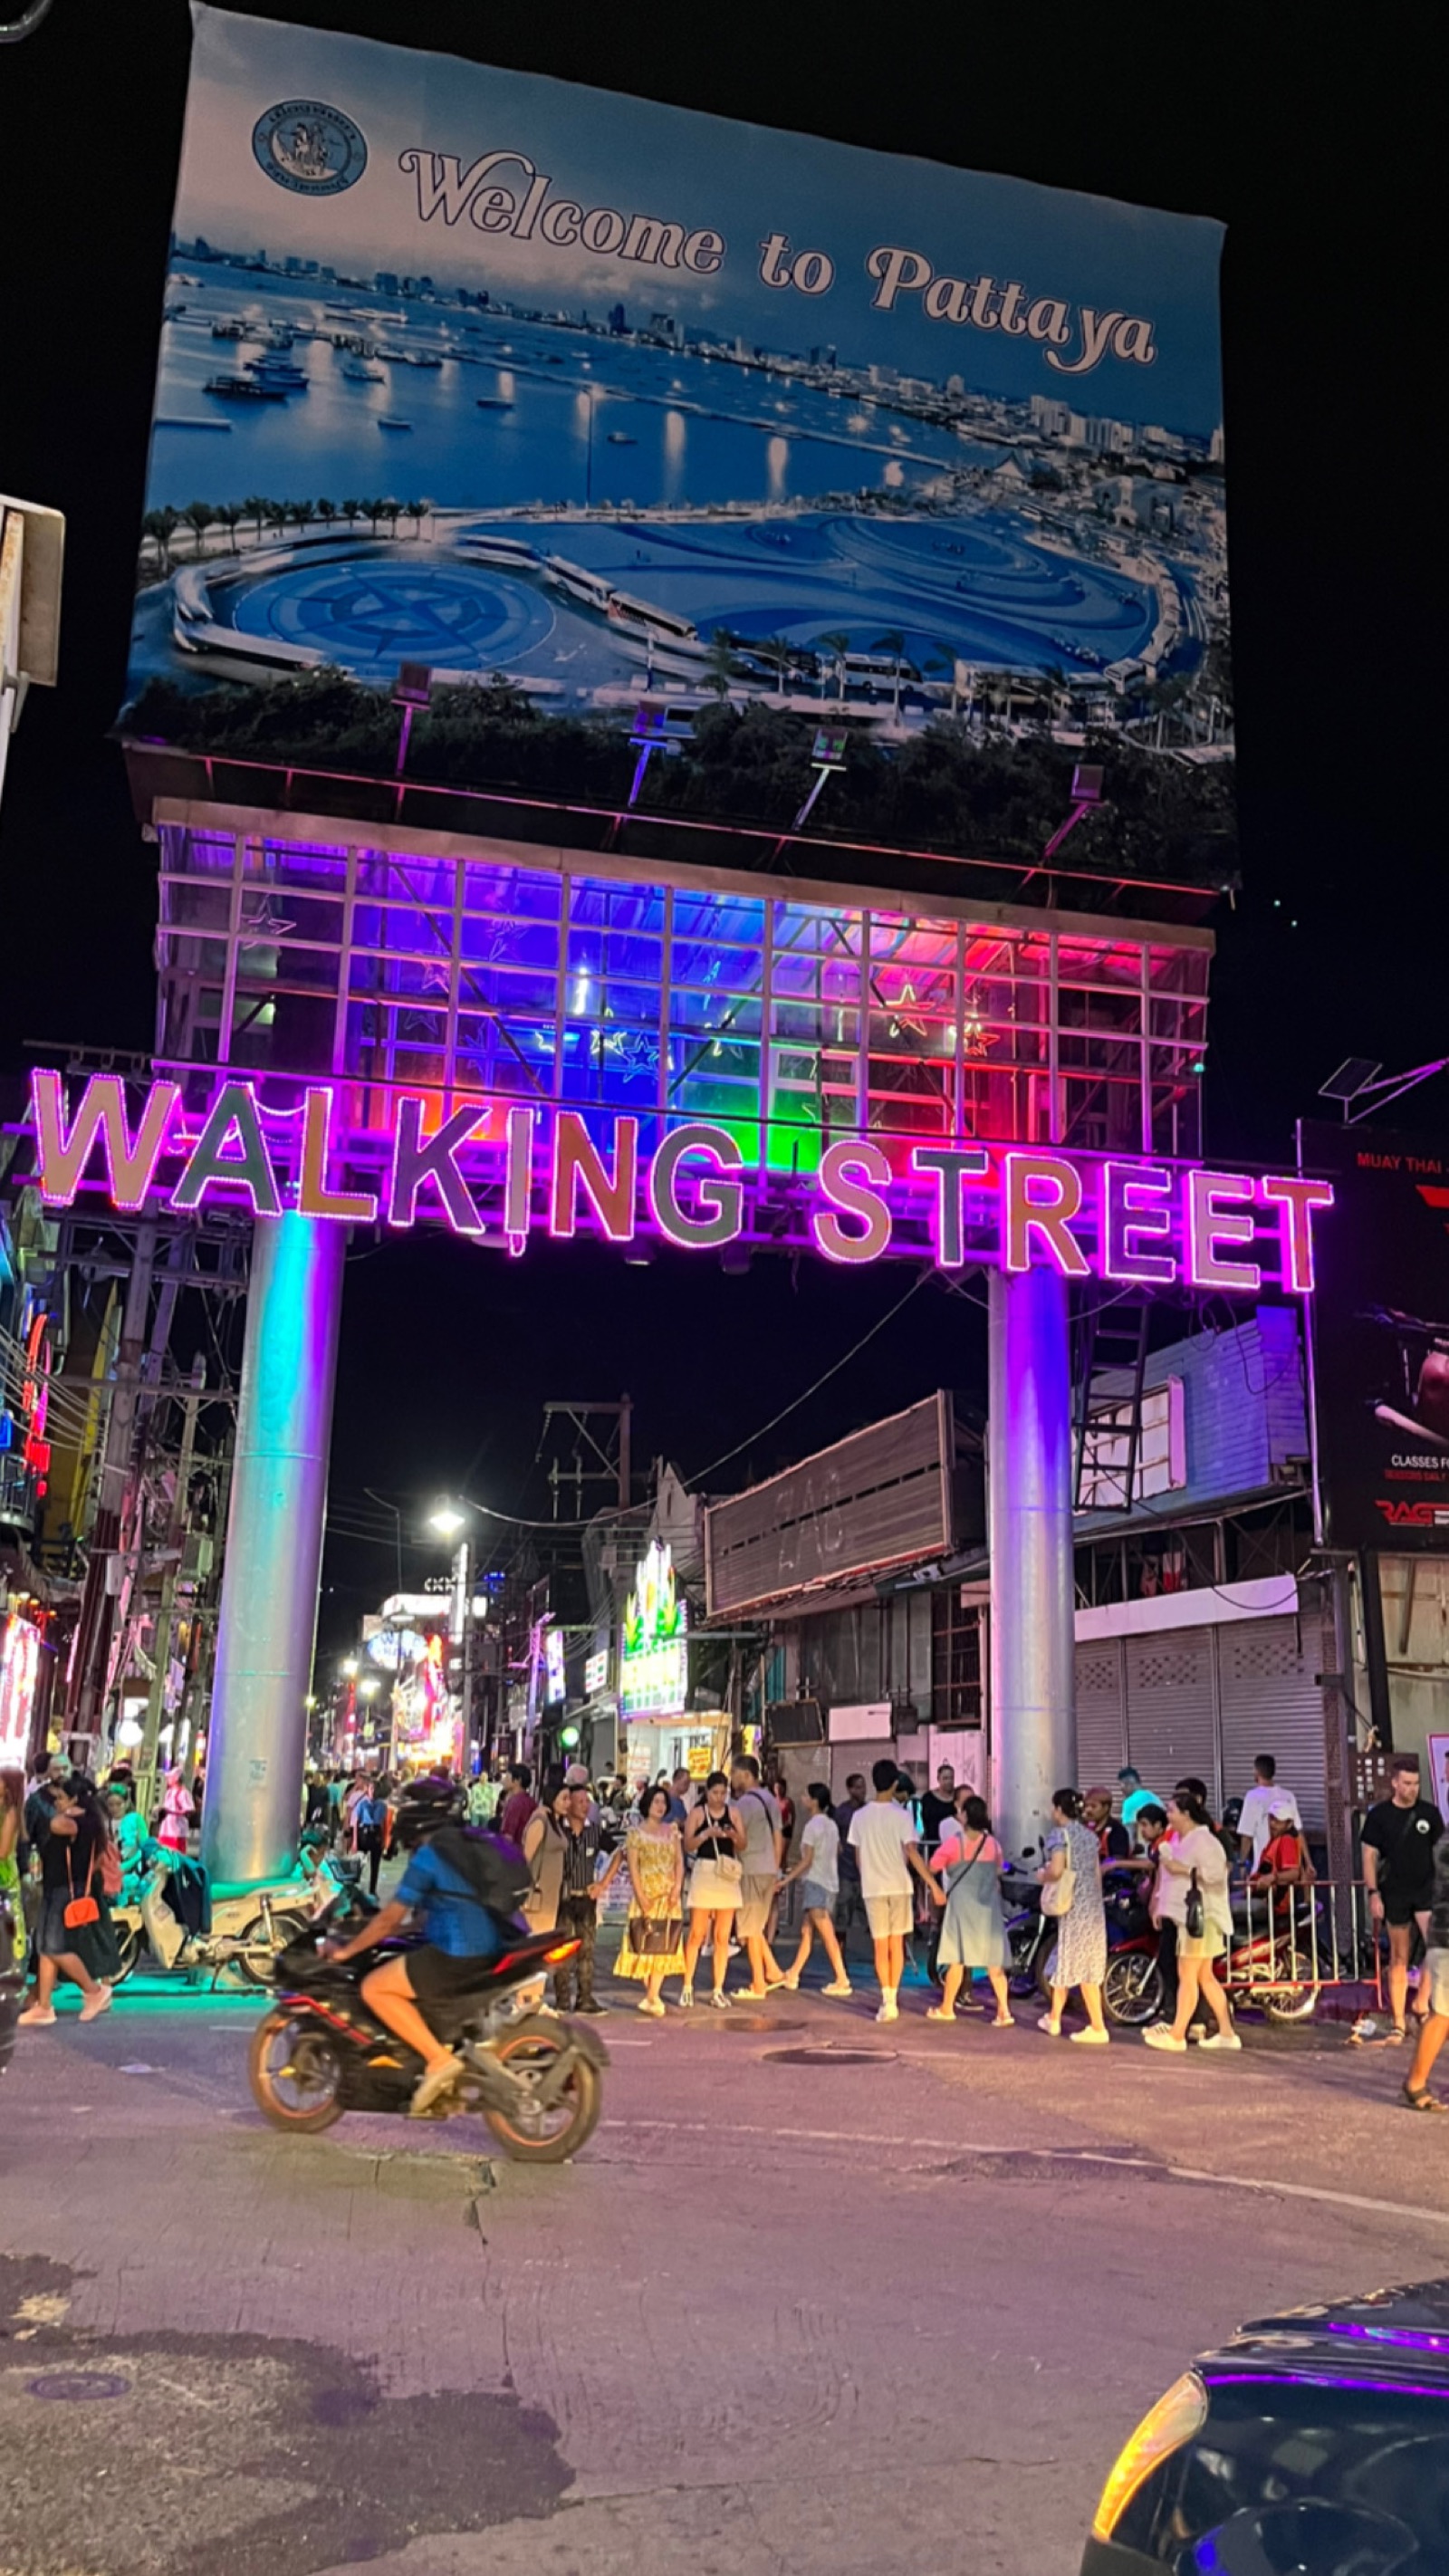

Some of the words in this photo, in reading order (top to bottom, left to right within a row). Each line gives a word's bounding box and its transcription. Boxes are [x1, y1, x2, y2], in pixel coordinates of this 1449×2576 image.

[398, 147, 725, 274] Welcome
[758, 232, 834, 295] to
[866, 245, 1156, 375] Pattaya
[31, 1067, 744, 1250] WALKING
[813, 1139, 1335, 1293] STREET
[1357, 1152, 1400, 1169] MUAY
[1406, 1157, 1442, 1174] THAI
[1390, 1454, 1439, 1468] CLASSES
